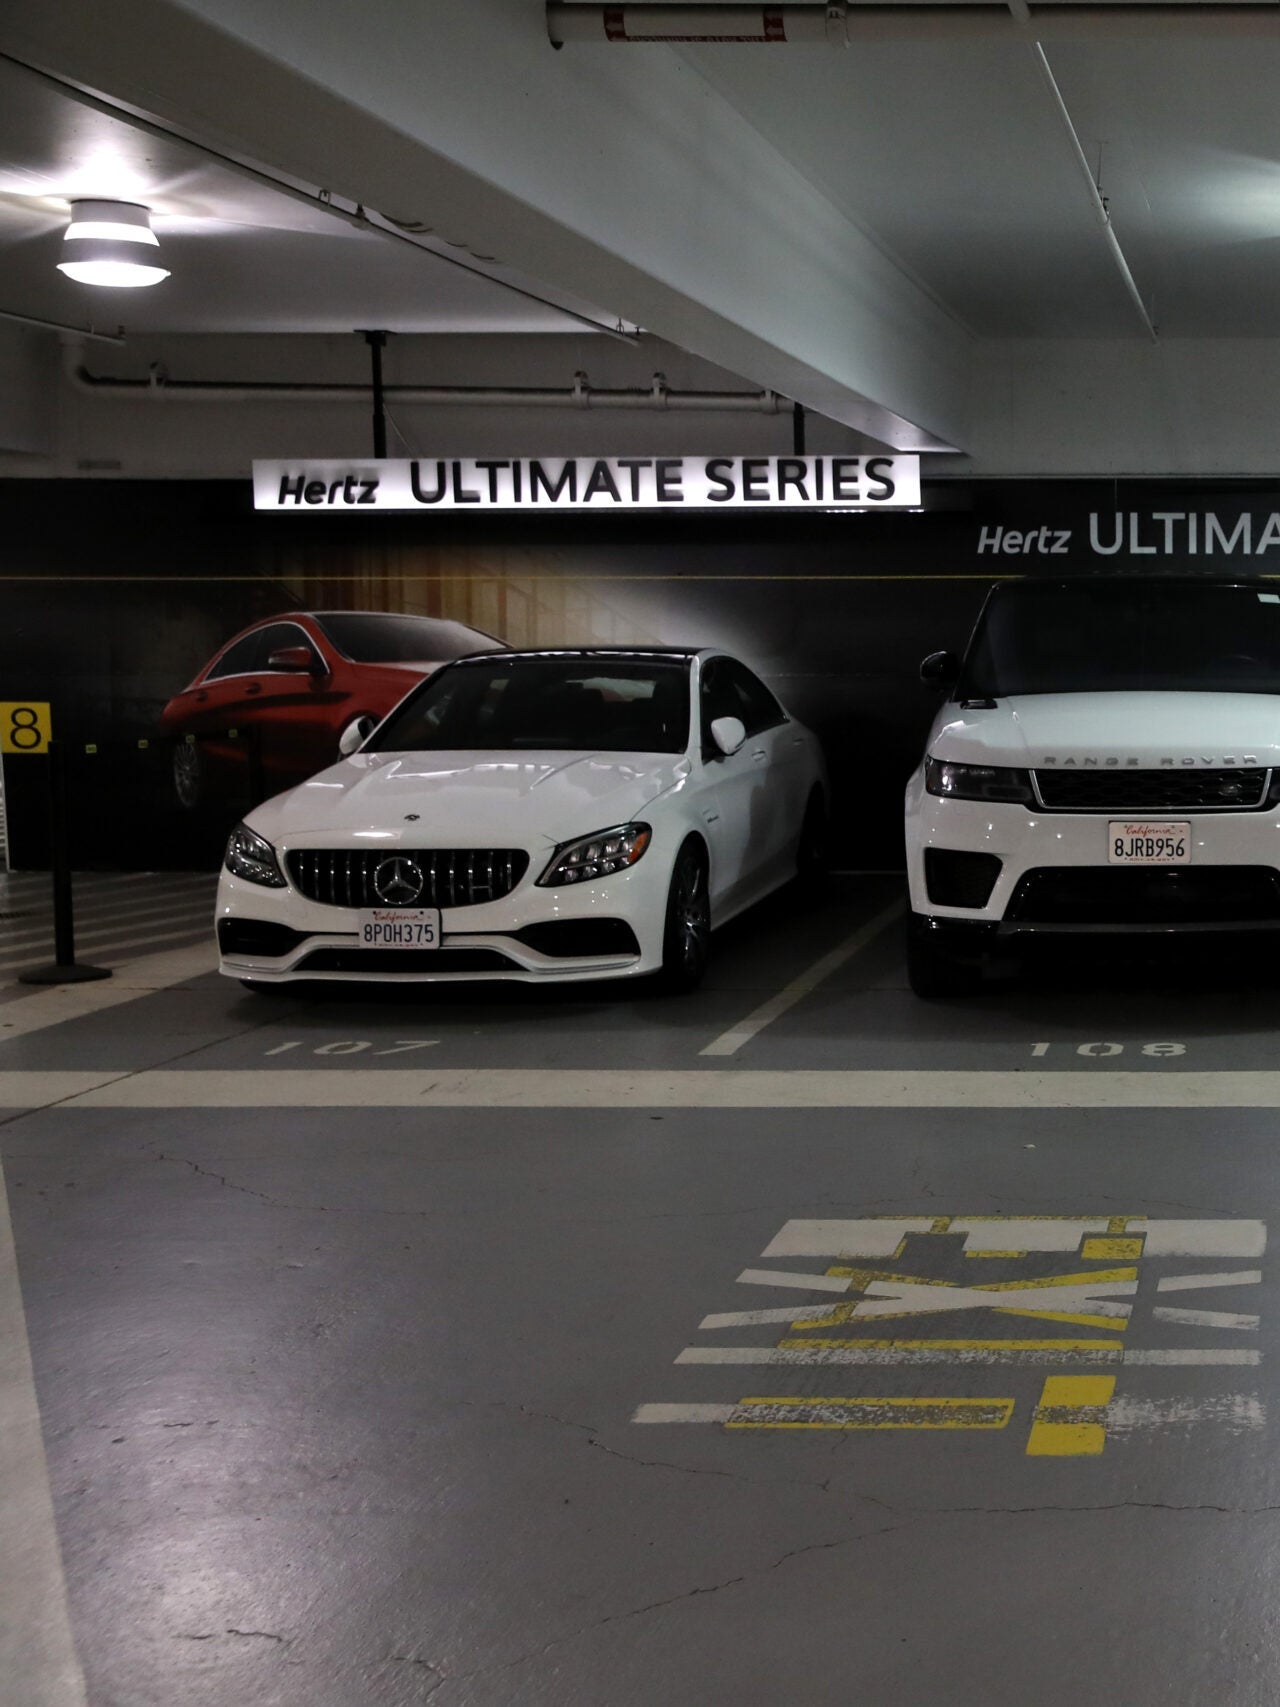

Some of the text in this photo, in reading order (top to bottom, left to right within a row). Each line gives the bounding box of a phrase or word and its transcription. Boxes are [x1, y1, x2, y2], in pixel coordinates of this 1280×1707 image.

[278, 458, 895, 504] Hertz ULTIMATE SERIES
[977, 525, 1072, 555] Hertz
[10, 707, 42, 749] 8
[1044, 754, 1258, 766] RANGE ROVER
[1126, 824, 1176, 838] California
[1114, 838, 1185, 857] 8JRB956
[264, 1041, 439, 1055] 107
[1030, 1042, 1187, 1057] 108
